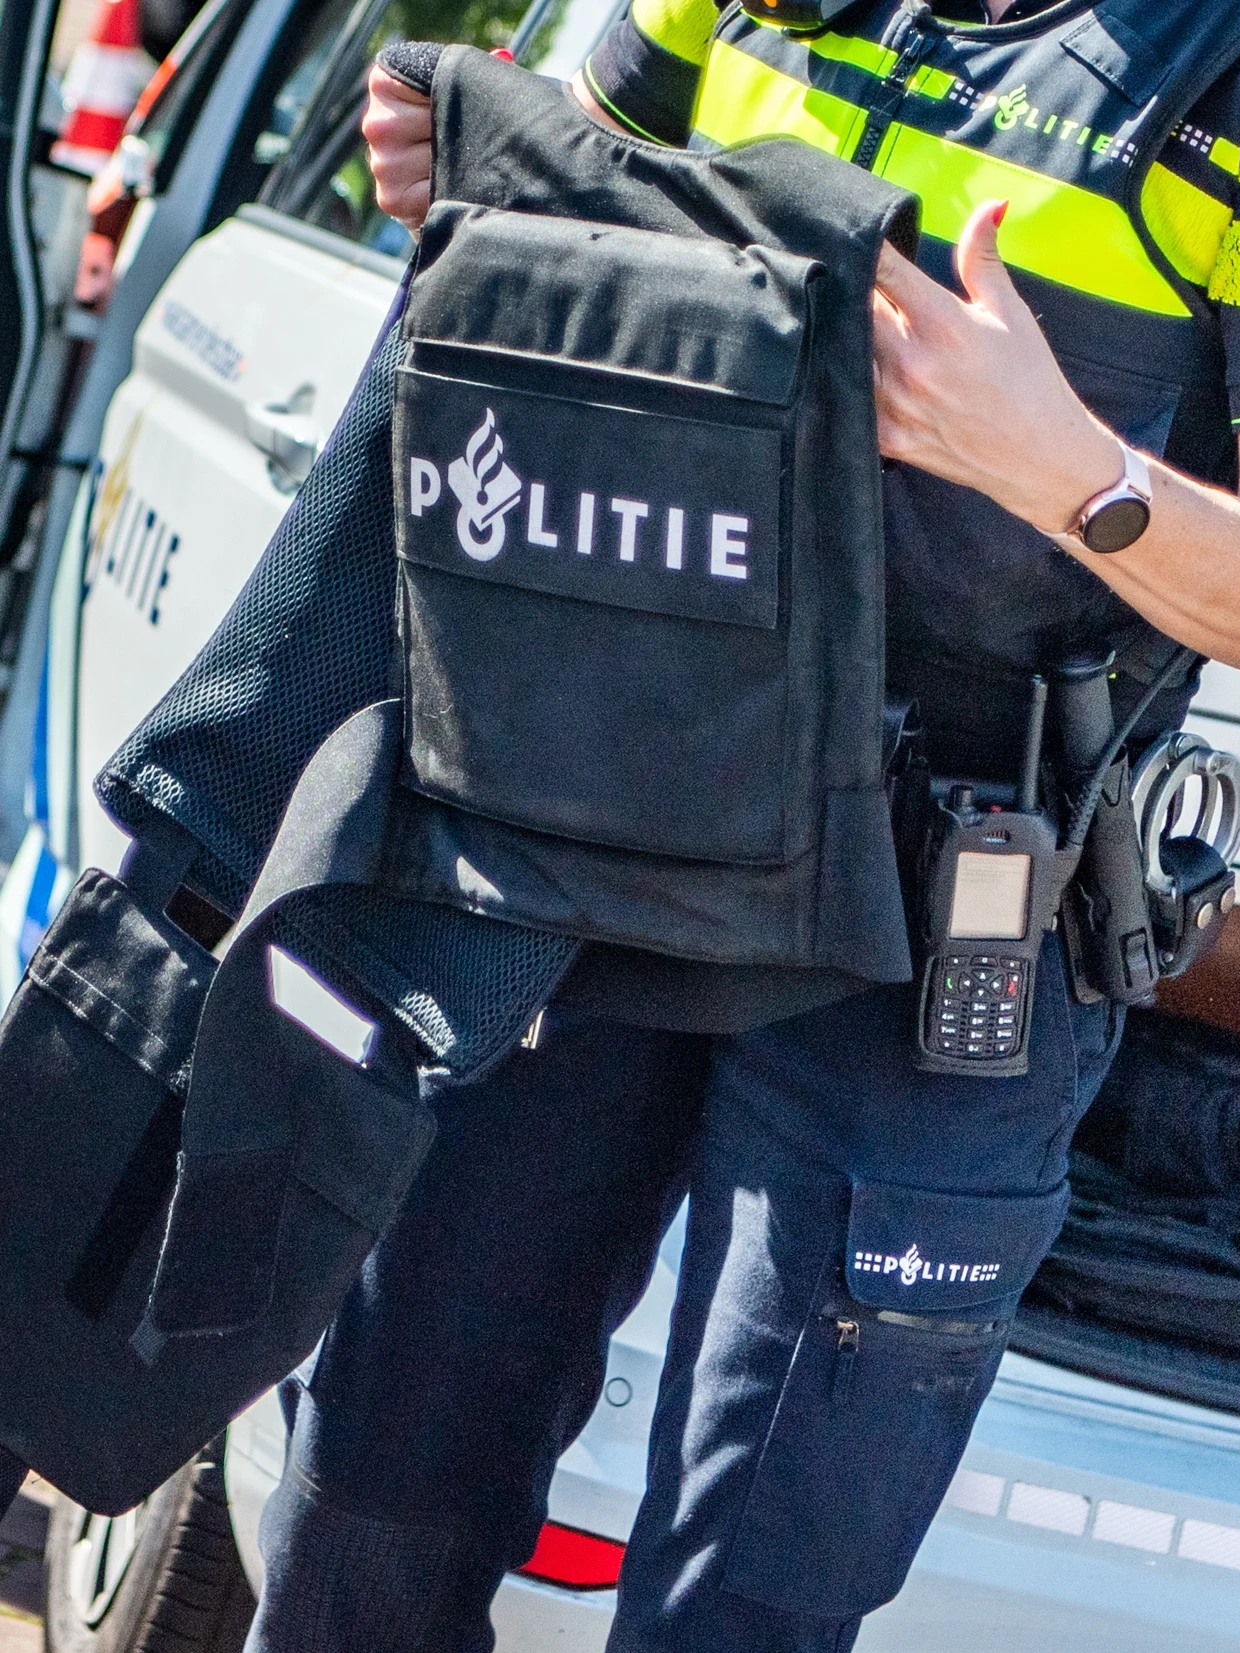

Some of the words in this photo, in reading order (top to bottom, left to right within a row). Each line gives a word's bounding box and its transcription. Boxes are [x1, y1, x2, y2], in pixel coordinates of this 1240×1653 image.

[978, 94, 1113, 155] POLITIE
[410, 456, 749, 580] POLITIE
[884, 1255, 982, 1286] POLITIE
